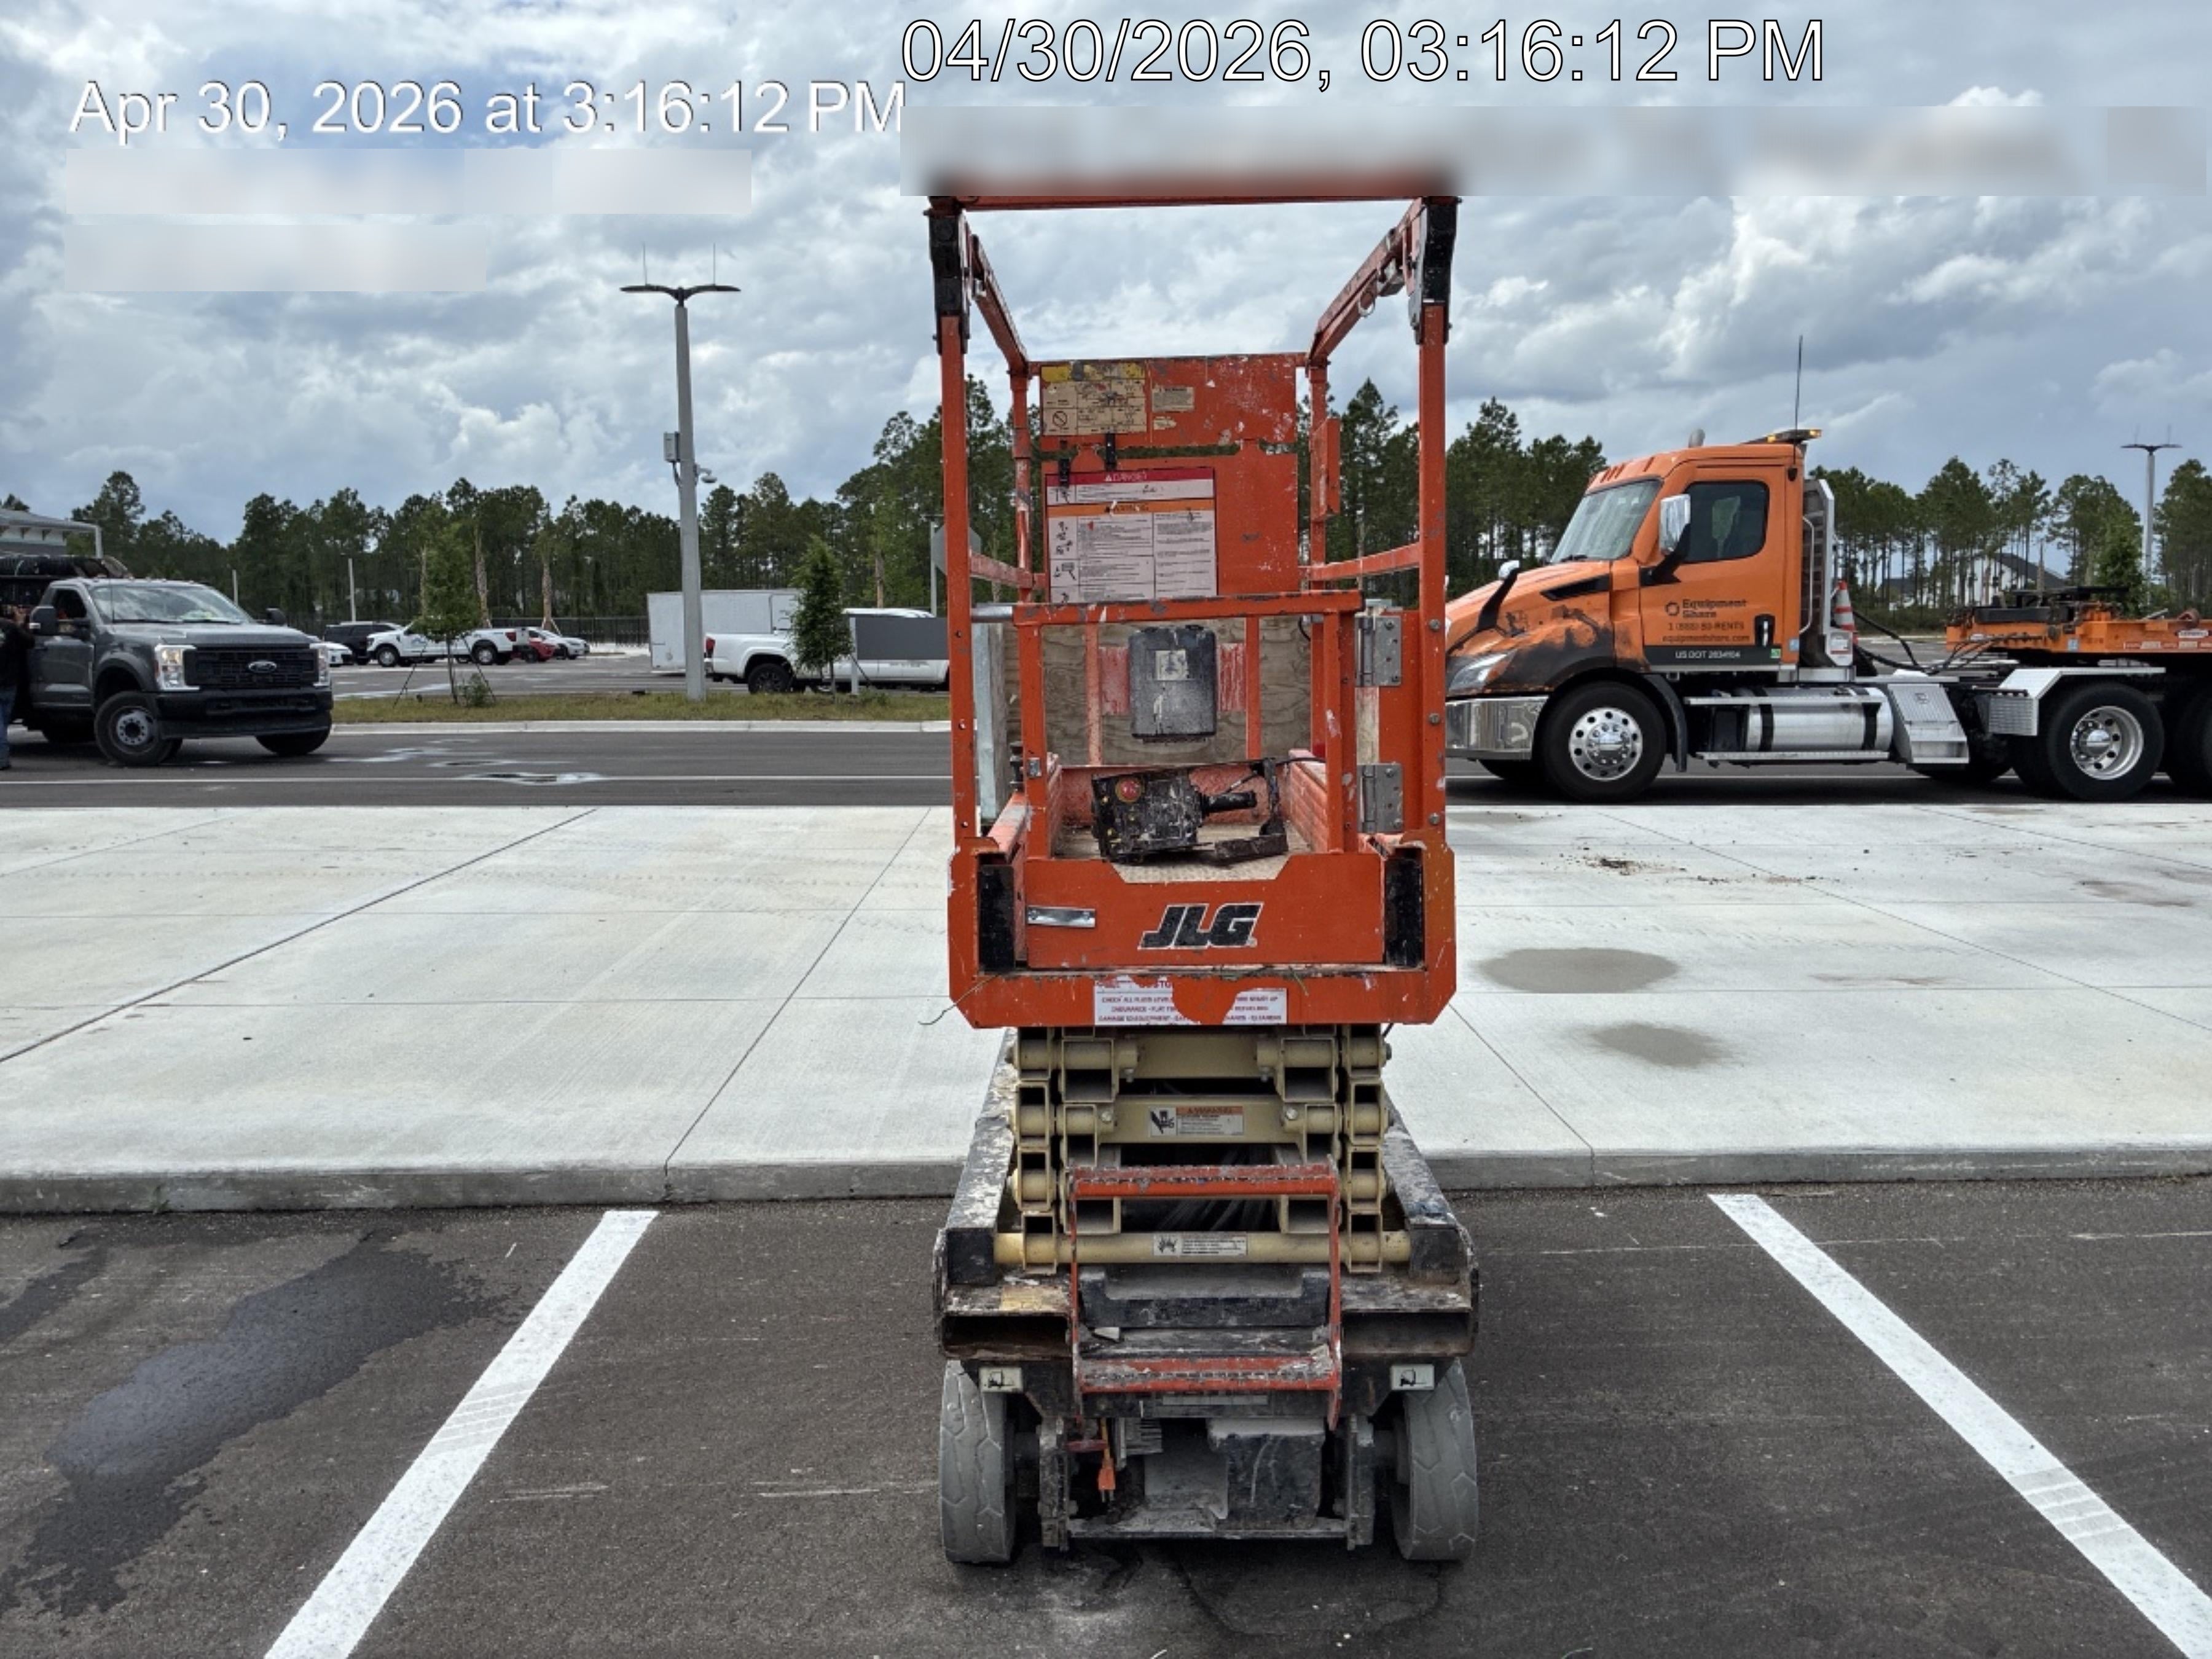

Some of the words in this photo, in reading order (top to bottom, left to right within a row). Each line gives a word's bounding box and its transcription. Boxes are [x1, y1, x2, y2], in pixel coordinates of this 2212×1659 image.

[1682, 599, 1747, 610] Equipment
[1662, 634, 1750, 643] equipmentshare.com
[1137, 902, 1265, 951] JLG
